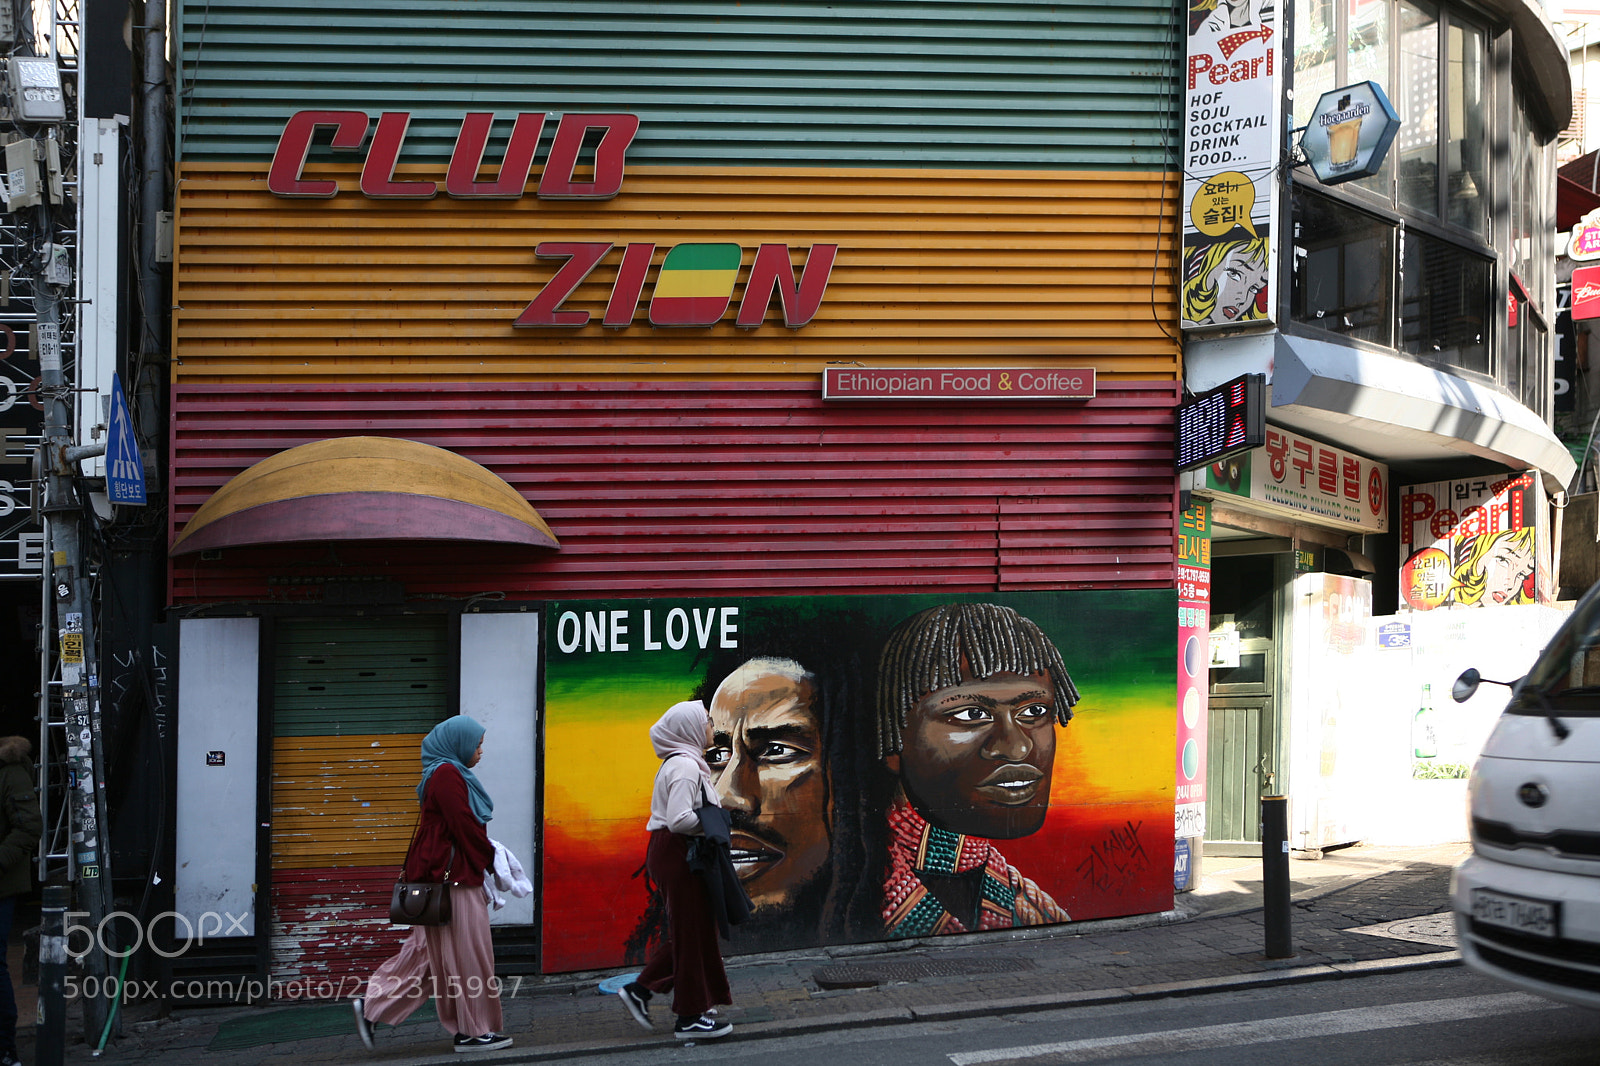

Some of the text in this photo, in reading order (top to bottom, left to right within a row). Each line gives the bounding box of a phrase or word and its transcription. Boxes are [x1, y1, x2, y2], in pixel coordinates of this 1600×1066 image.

[1188, 48, 1274, 90] Pearl
[1190, 92, 1223, 108] HOF
[1190, 106, 1230, 122] SOJU
[1319, 104, 1370, 127] Hoegaarden
[1190, 115, 1267, 137] COCKTAIL
[1189, 134, 1240, 152] DRINK
[267, 110, 639, 199] CLUB
[1203, 181, 1239, 196] 요리가
[1212, 196, 1229, 207] 있는
[1203, 205, 1243, 226] 술집!
[512, 242, 839, 329] ZION
[837, 372, 1083, 393] Ethiopian Food & Coffee
[1265, 429, 1361, 503] 당구클럽
[114, 481, 142, 499] 횡단보도
[1454, 481, 1488, 500] 입구
[1401, 489, 1524, 545] Pearl
[1411, 556, 1447, 570] 요리가
[1409, 583, 1445, 600] 술집!
[557, 607, 739, 654] ONE LOVE
